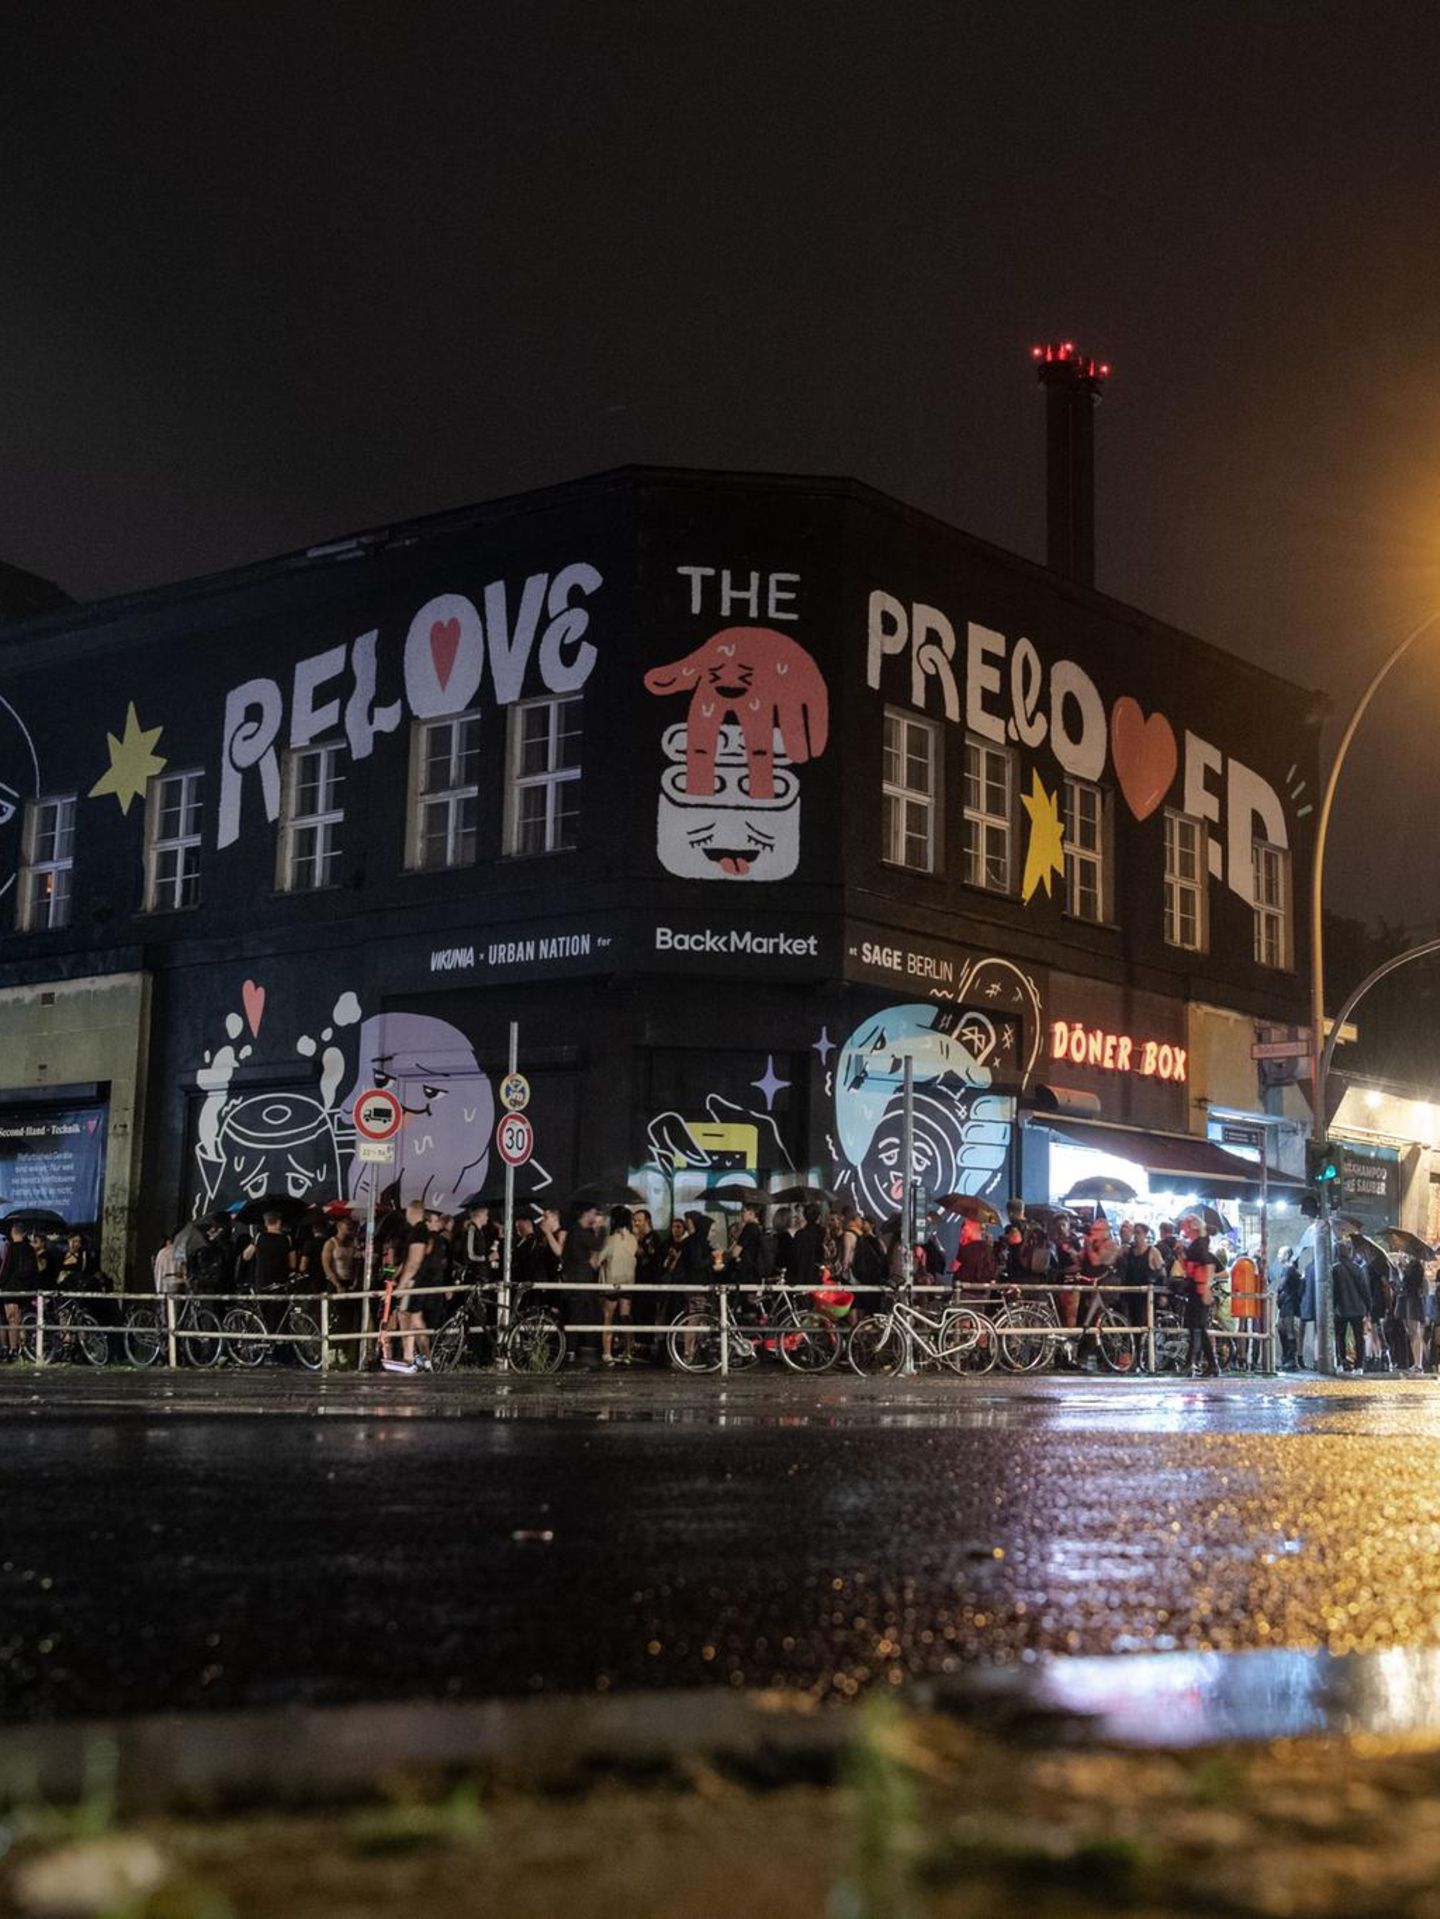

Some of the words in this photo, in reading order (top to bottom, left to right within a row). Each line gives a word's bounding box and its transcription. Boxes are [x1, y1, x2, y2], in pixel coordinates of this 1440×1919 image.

[677, 566, 800, 620] THE
[217, 562, 603, 850] RELOVE
[488, 940, 535, 965] URBAN
[539, 933, 591, 960] NATION
[597, 937, 611, 947] for
[861, 942, 902, 971] SAGE
[907, 953, 953, 982] BERLIN
[1052, 1021, 1132, 1071] DÖNER
[1143, 1040, 1187, 1082] BOX
[506, 1127, 525, 1151] 30
